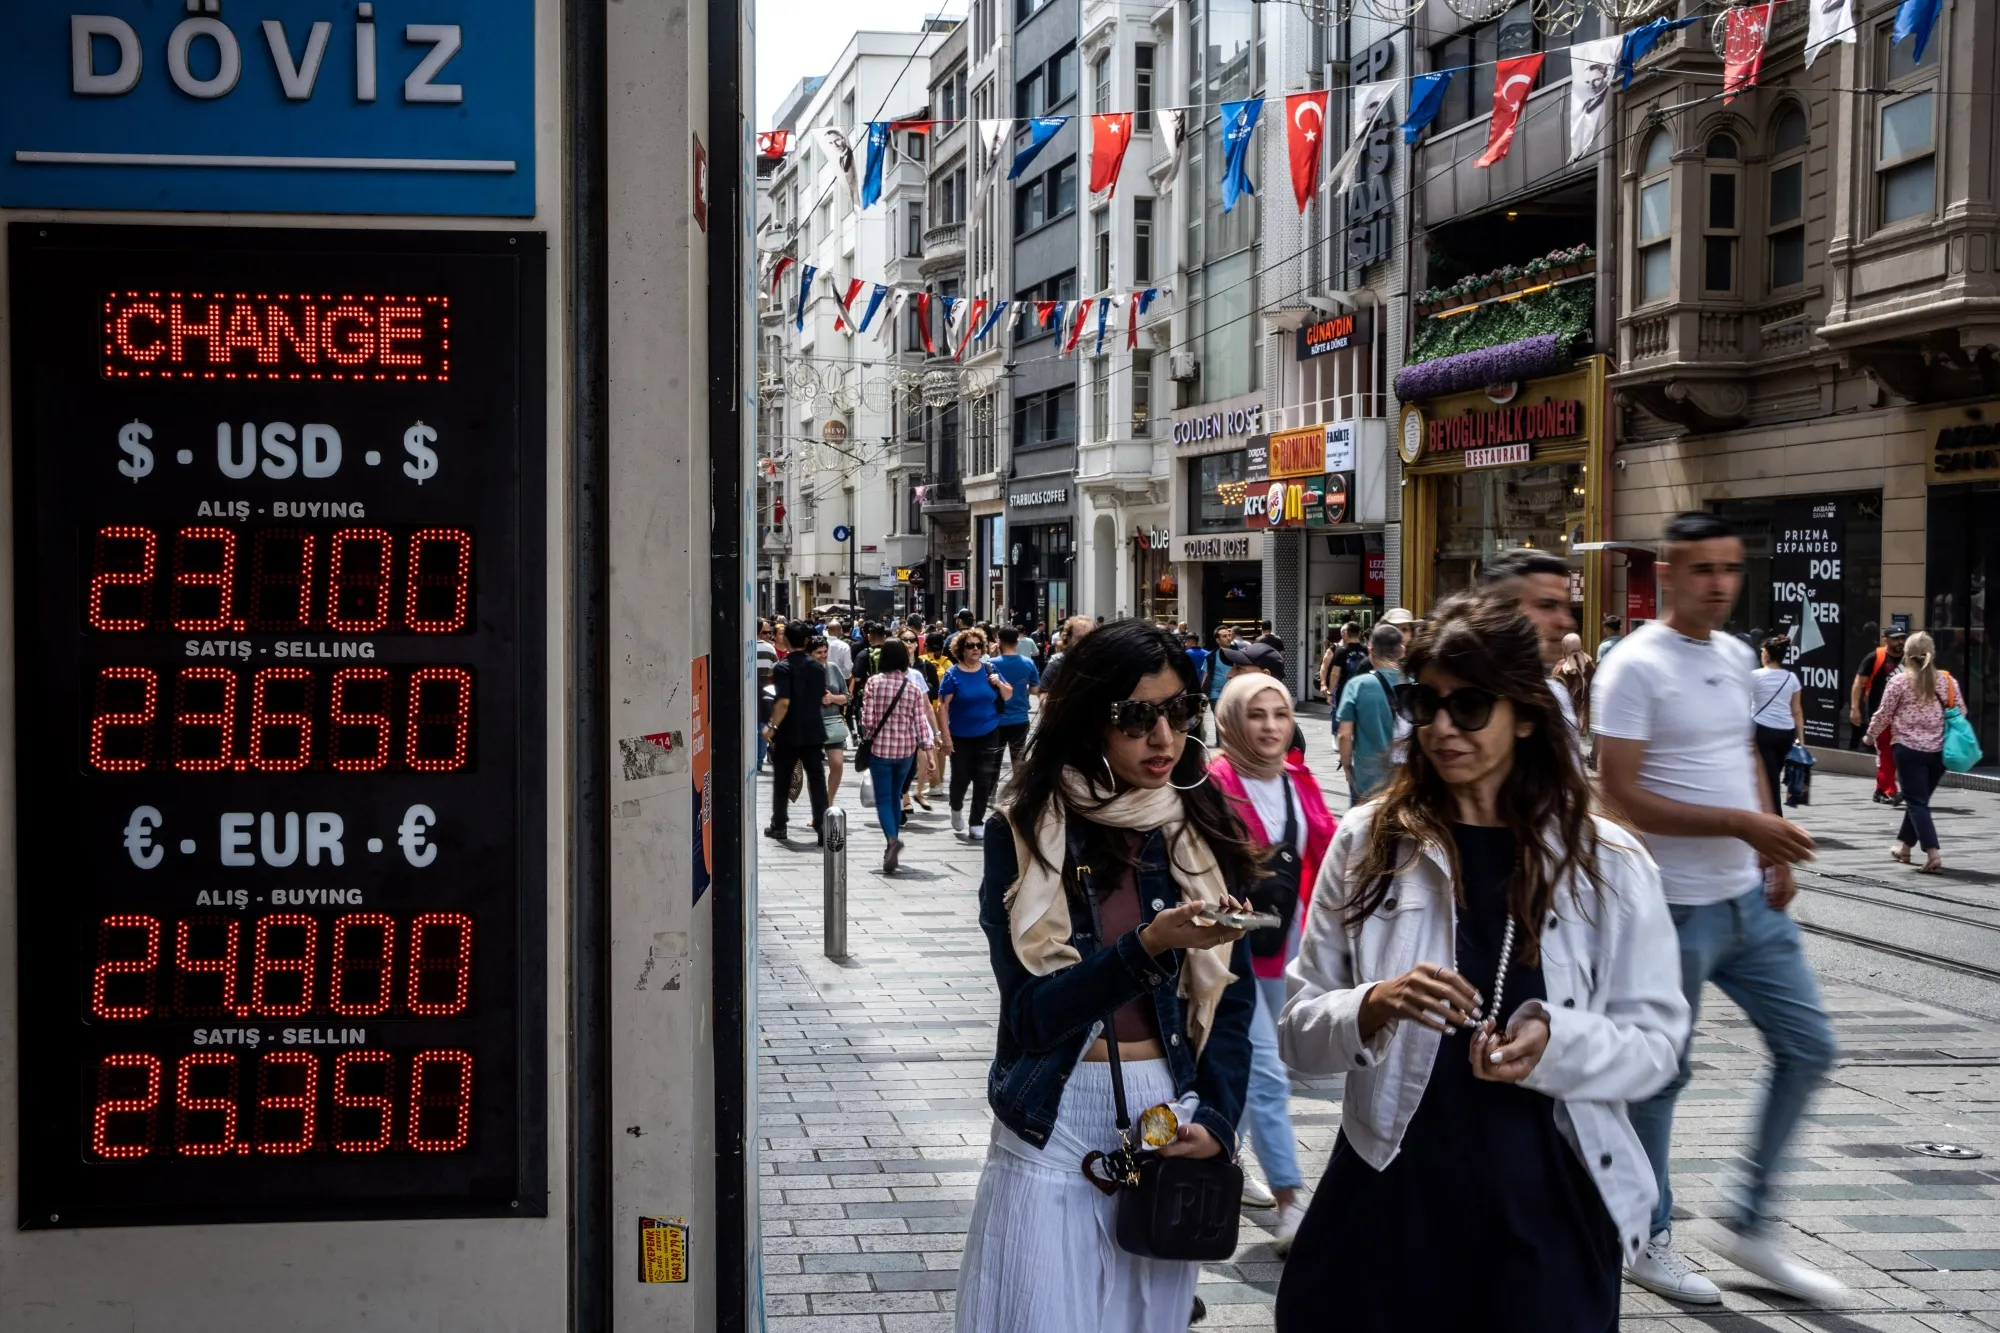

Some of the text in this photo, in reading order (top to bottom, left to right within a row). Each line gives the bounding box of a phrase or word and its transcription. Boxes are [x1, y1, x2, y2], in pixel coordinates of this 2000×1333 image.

[71, 0, 463, 103] DÖVİZ
[116, 303, 422, 365] CHANGE
[1307, 315, 1353, 345] GÜNAYDIN
[1311, 342, 1327, 355] KÖFTE
[1331, 337, 1348, 350] DÖNER
[1172, 404, 1262, 445] GOLDEN ROSE
[1488, 407, 1522, 444] HALK
[118, 418, 439, 486] $ USD $
[1281, 434, 1321, 472] BOWLING
[1467, 445, 1529, 466] RESTAURANT
[1934, 449, 2000, 473] SANA
[1010, 489, 1066, 507] STARBUCKS COFFEE
[1244, 495, 1266, 516] KFC
[197, 500, 250, 522] ALIŞ
[273, 501, 365, 519] BUYING
[1785, 529, 1829, 541] PRIZMA
[1184, 537, 1249, 559] GOLDEN ROSE
[1776, 541, 1837, 553] EXPANDED
[89, 525, 471, 632] 23.100
[949, 574, 960, 586] E
[1369, 570, 1385, 581] UÇA
[1810, 559, 1841, 580] POE
[1773, 581, 1817, 602] TICS OF
[1810, 602, 1840, 623] PER
[185, 639, 252, 662] SATIŞ
[274, 641, 375, 659] SELLING
[1801, 666, 1839, 690] TION
[90, 667, 471, 772] 23.650
[659, 736, 671, 747] 14
[123, 803, 438, 870] € EUR €
[196, 889, 249, 910] ALIŞ
[271, 888, 364, 905] BUYING
[92, 913, 472, 1019] 24.800
[193, 1028, 260, 1049] SATIŞ
[282, 1028, 366, 1045] SELLIN
[93, 1050, 473, 1158] 25.350
[646, 1230, 657, 1262] KEPENK
[669, 1229, 682, 1280] 0543 247 79 47
